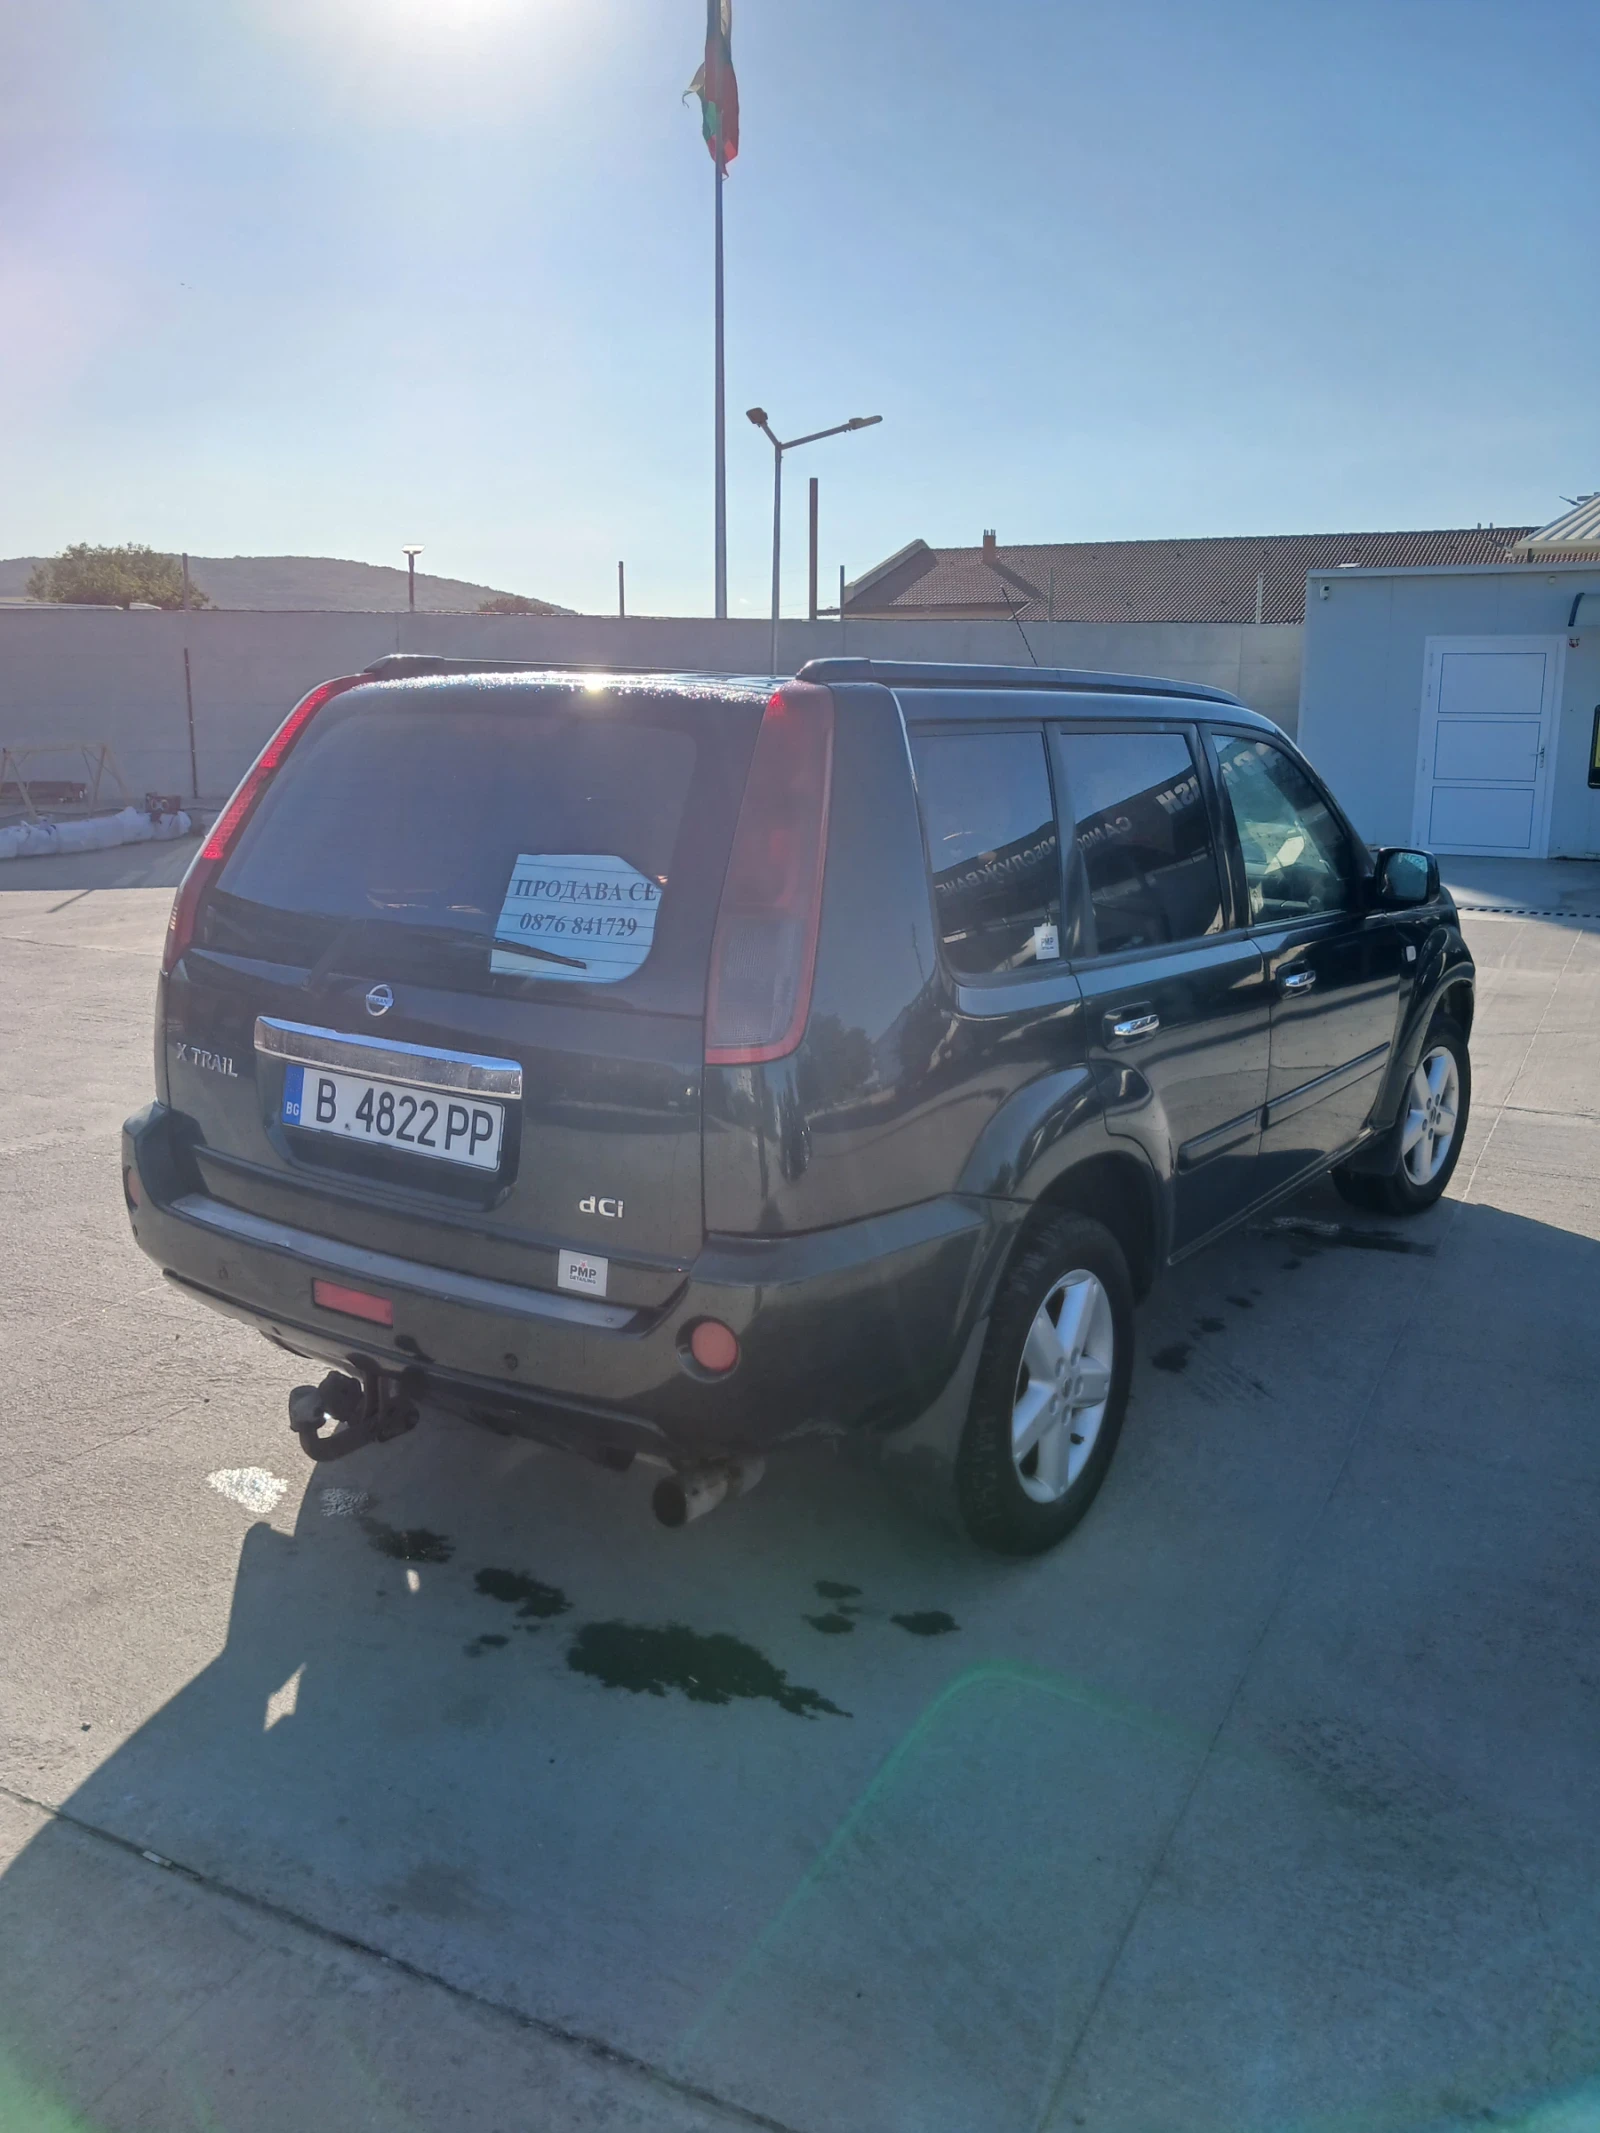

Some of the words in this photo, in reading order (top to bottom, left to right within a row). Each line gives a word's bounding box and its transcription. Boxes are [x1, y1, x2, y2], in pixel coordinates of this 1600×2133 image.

[515, 879, 622, 903] ПРОДАВА
[629, 882, 658, 901] СЕ
[519, 912, 566, 933] 0876
[571, 916, 638, 937] 841729
[191, 1047, 239, 1078] TRAIL
[286, 1101, 300, 1116] BG
[579, 1195, 625, 1219] dCi
[570, 1264, 597, 1279] PMP
